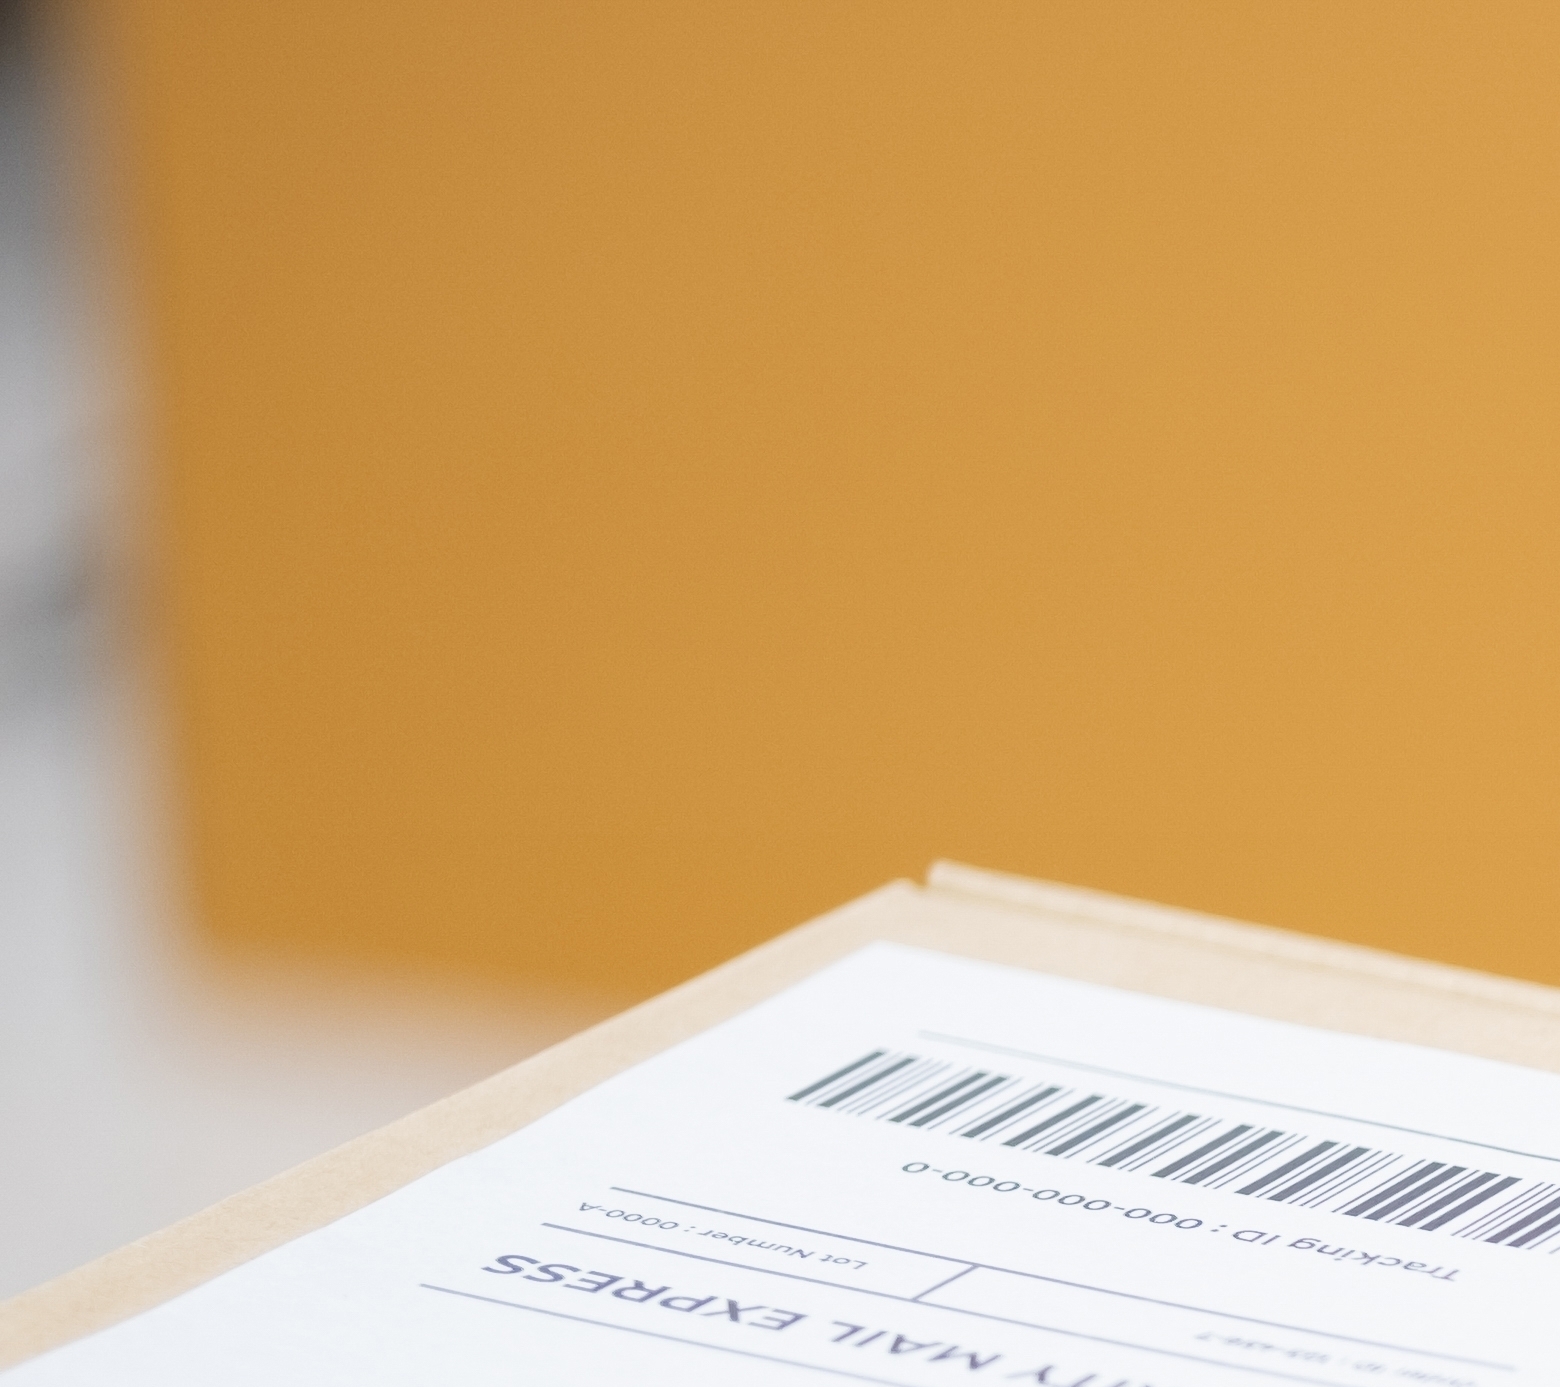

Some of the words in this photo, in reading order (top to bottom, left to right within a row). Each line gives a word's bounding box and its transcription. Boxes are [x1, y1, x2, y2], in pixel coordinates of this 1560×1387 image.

[900, 1161, 1202, 1230] 000-000-000-0
[577, 1202, 680, 1230] 0000-A
[696, 1226, 815, 1259] Number
[1232, 1227, 1282, 1245] ID
[820, 1254, 868, 1270] Lot
[1287, 1237, 1461, 1282] Tracking
[479, 1253, 807, 1331] EXPRESS
[827, 1320, 1002, 1372] MAIL
